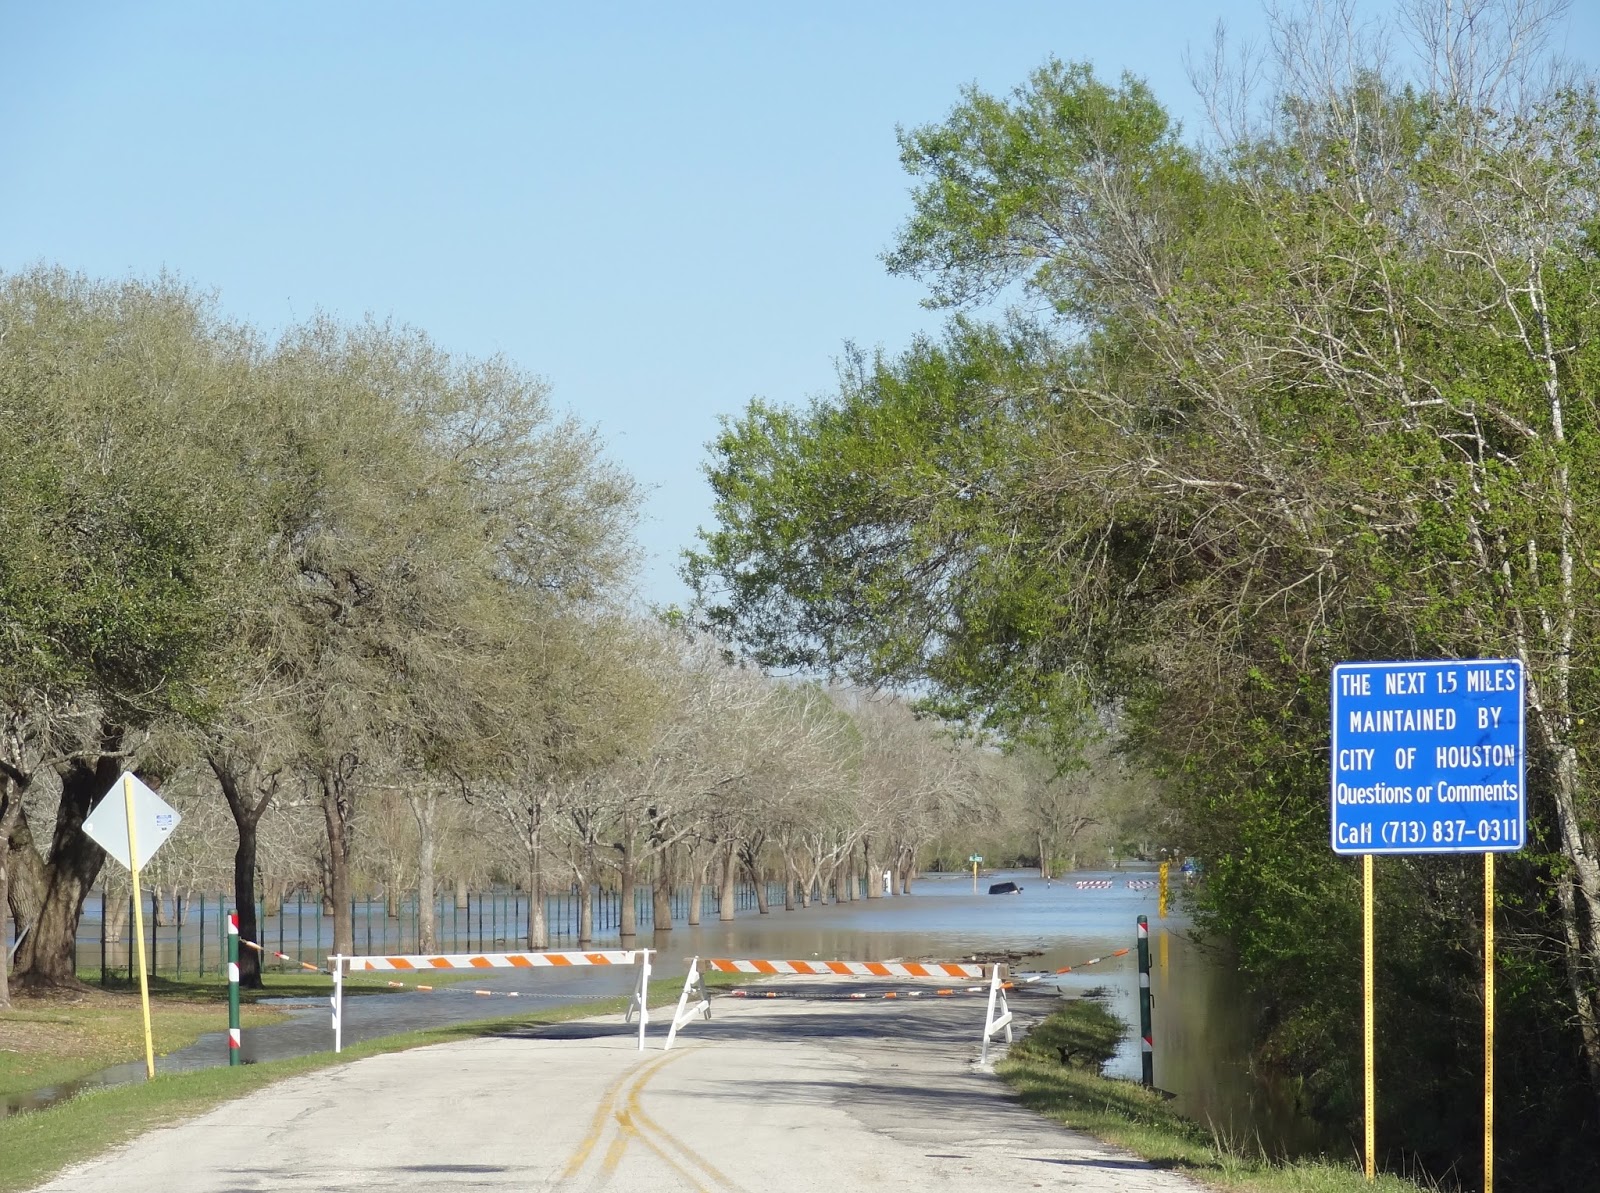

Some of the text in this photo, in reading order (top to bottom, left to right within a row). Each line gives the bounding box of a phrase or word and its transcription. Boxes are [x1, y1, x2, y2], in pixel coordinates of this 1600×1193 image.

[1341, 674, 1371, 696] THE
[1386, 672, 1426, 694] NEXT
[1468, 669, 1515, 692] MILES
[1350, 707, 1502, 732] MAINTAINED BY
[1340, 745, 1515, 770] CITY OF HOUSTON
[1338, 780, 1518, 805] Questions or Comments
[1339, 819, 1517, 843] Call (713) 837-0311
